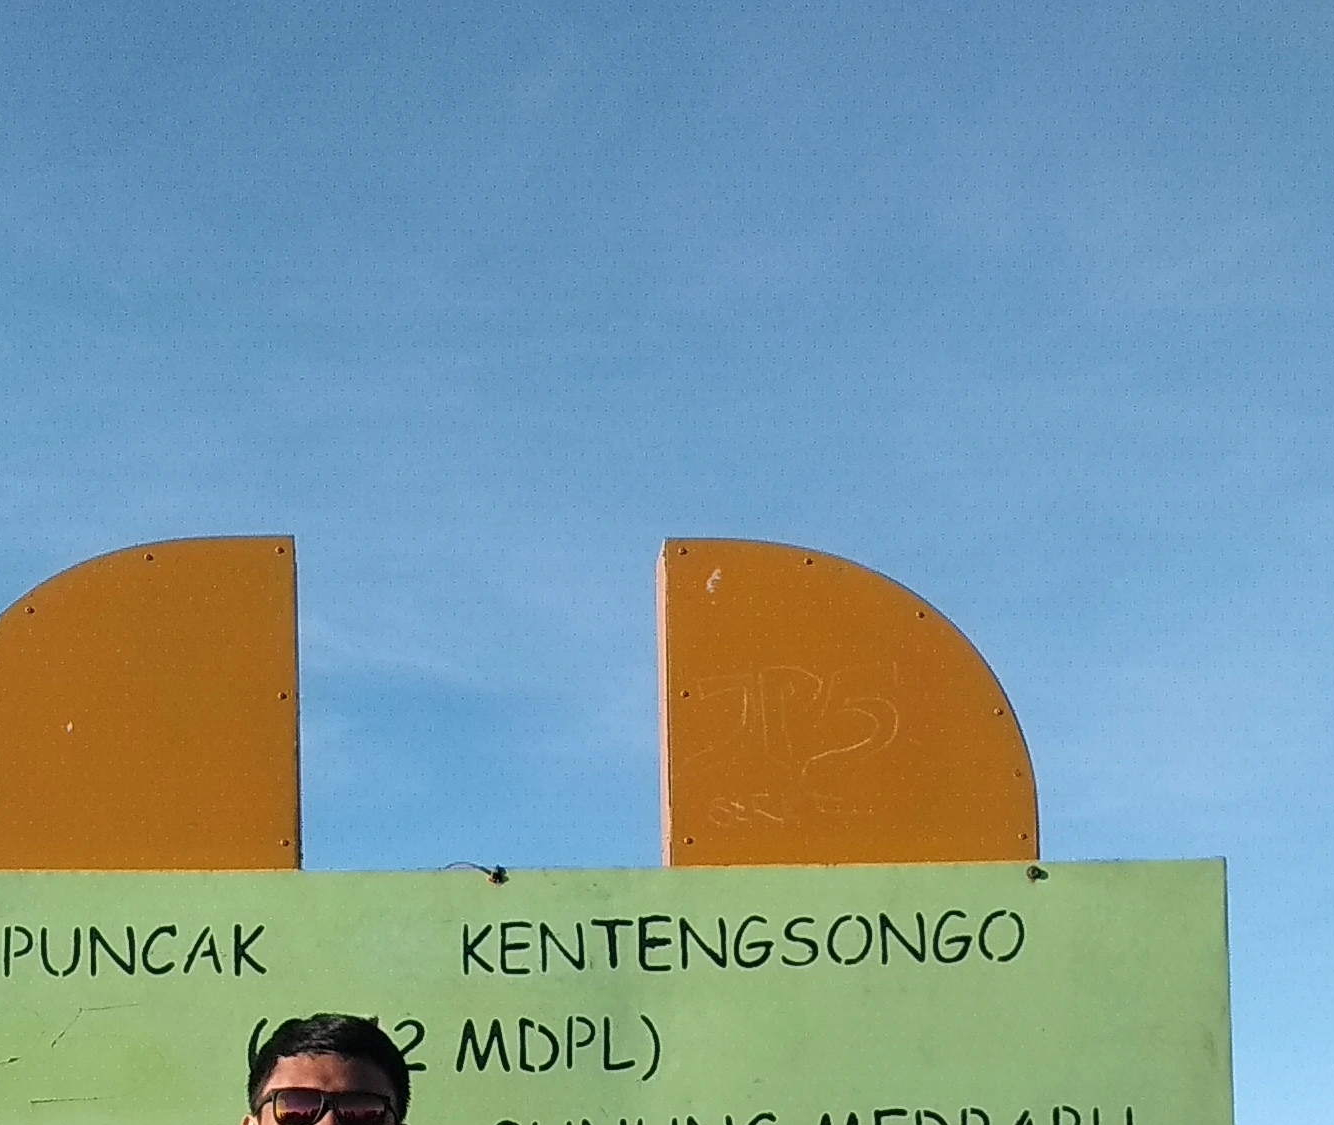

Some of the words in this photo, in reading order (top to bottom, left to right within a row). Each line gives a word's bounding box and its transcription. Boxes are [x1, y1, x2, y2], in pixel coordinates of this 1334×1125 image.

[3, 924, 267, 977] PUNCAK
[462, 910, 1025, 975] KENTENGSONGO
[456, 1014, 661, 1081] MDPL)
